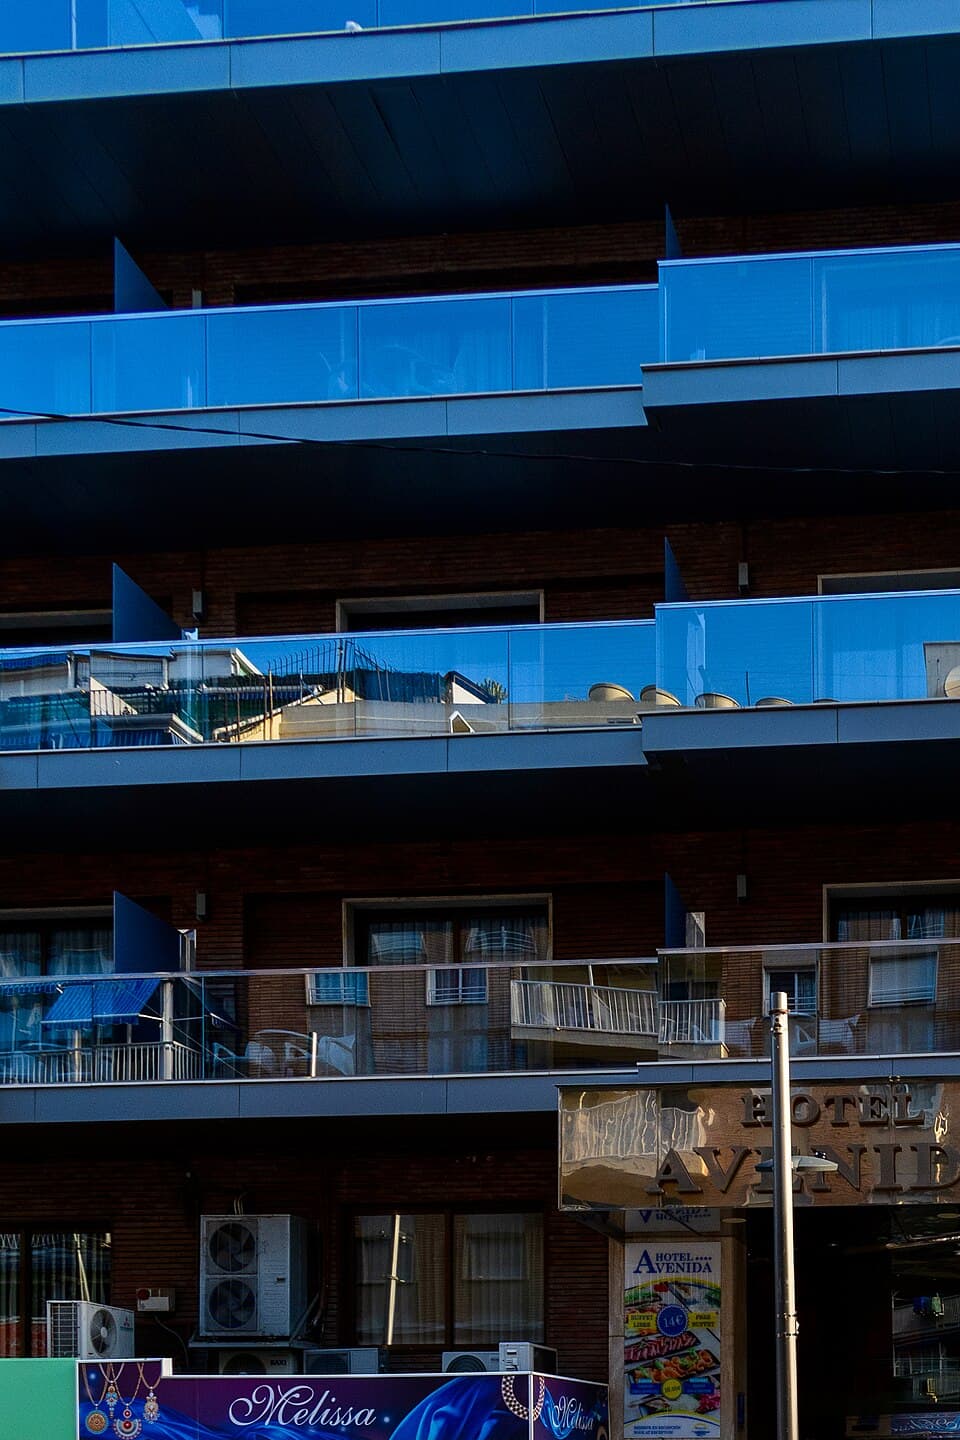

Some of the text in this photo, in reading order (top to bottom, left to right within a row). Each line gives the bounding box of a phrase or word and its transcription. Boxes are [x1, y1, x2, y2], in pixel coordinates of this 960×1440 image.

[740, 1094, 925, 1128] HOTEL
[633, 1249, 712, 1273] AVENIDA
[655, 1253, 693, 1261] HOTEL
[228, 1384, 377, 1426] Melissa
[552, 1396, 594, 1431] Melissa
